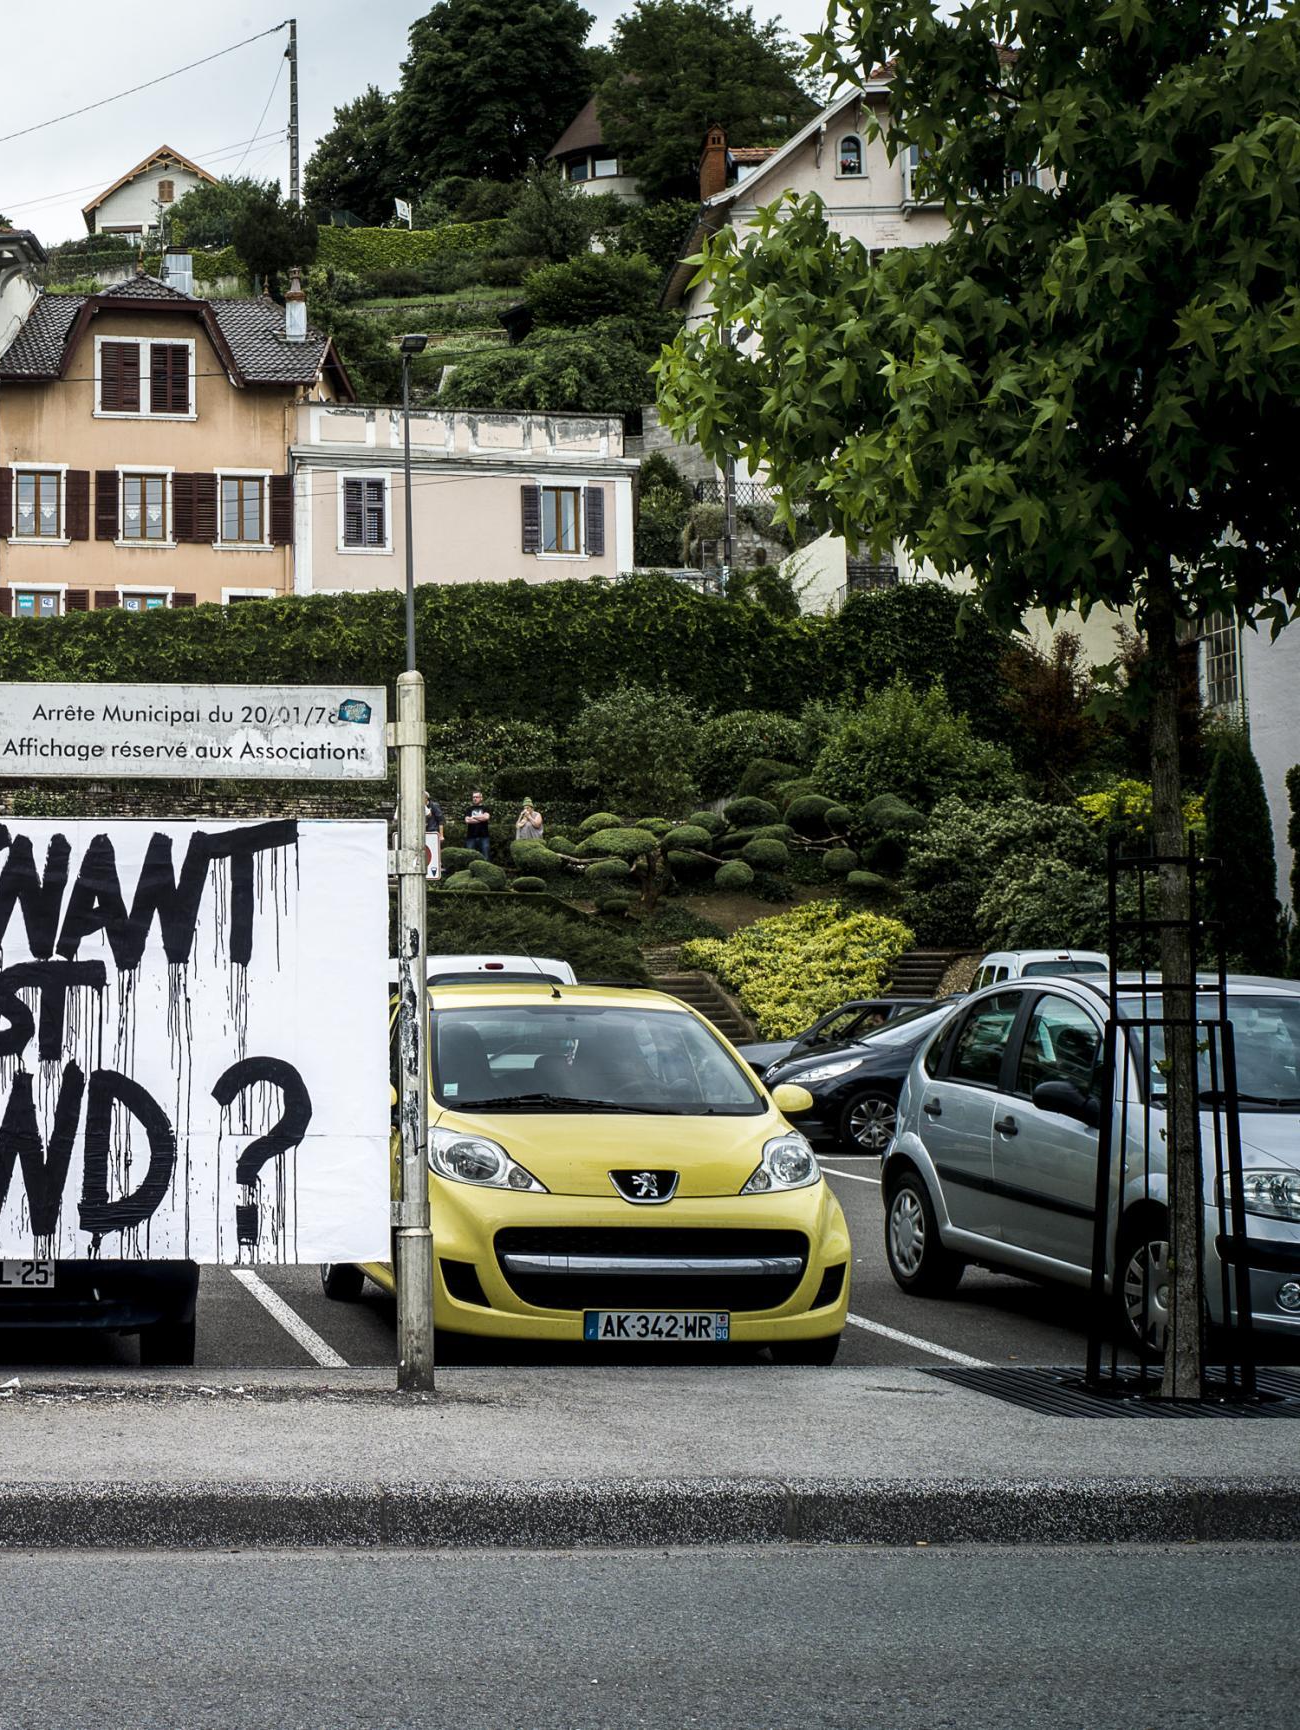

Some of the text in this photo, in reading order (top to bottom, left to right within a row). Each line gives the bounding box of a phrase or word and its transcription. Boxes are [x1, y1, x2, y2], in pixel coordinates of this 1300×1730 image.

[32, 704, 96, 722] Arrête
[102, 704, 201, 727] Municipal
[208, 705, 233, 723] du
[2, 737, 104, 762] Affichage
[111, 740, 188, 759] réservé
[195, 745, 233, 759] aux
[210, 1055, 313, 1247] ?
[21, 1261, 50, 1285] 25
